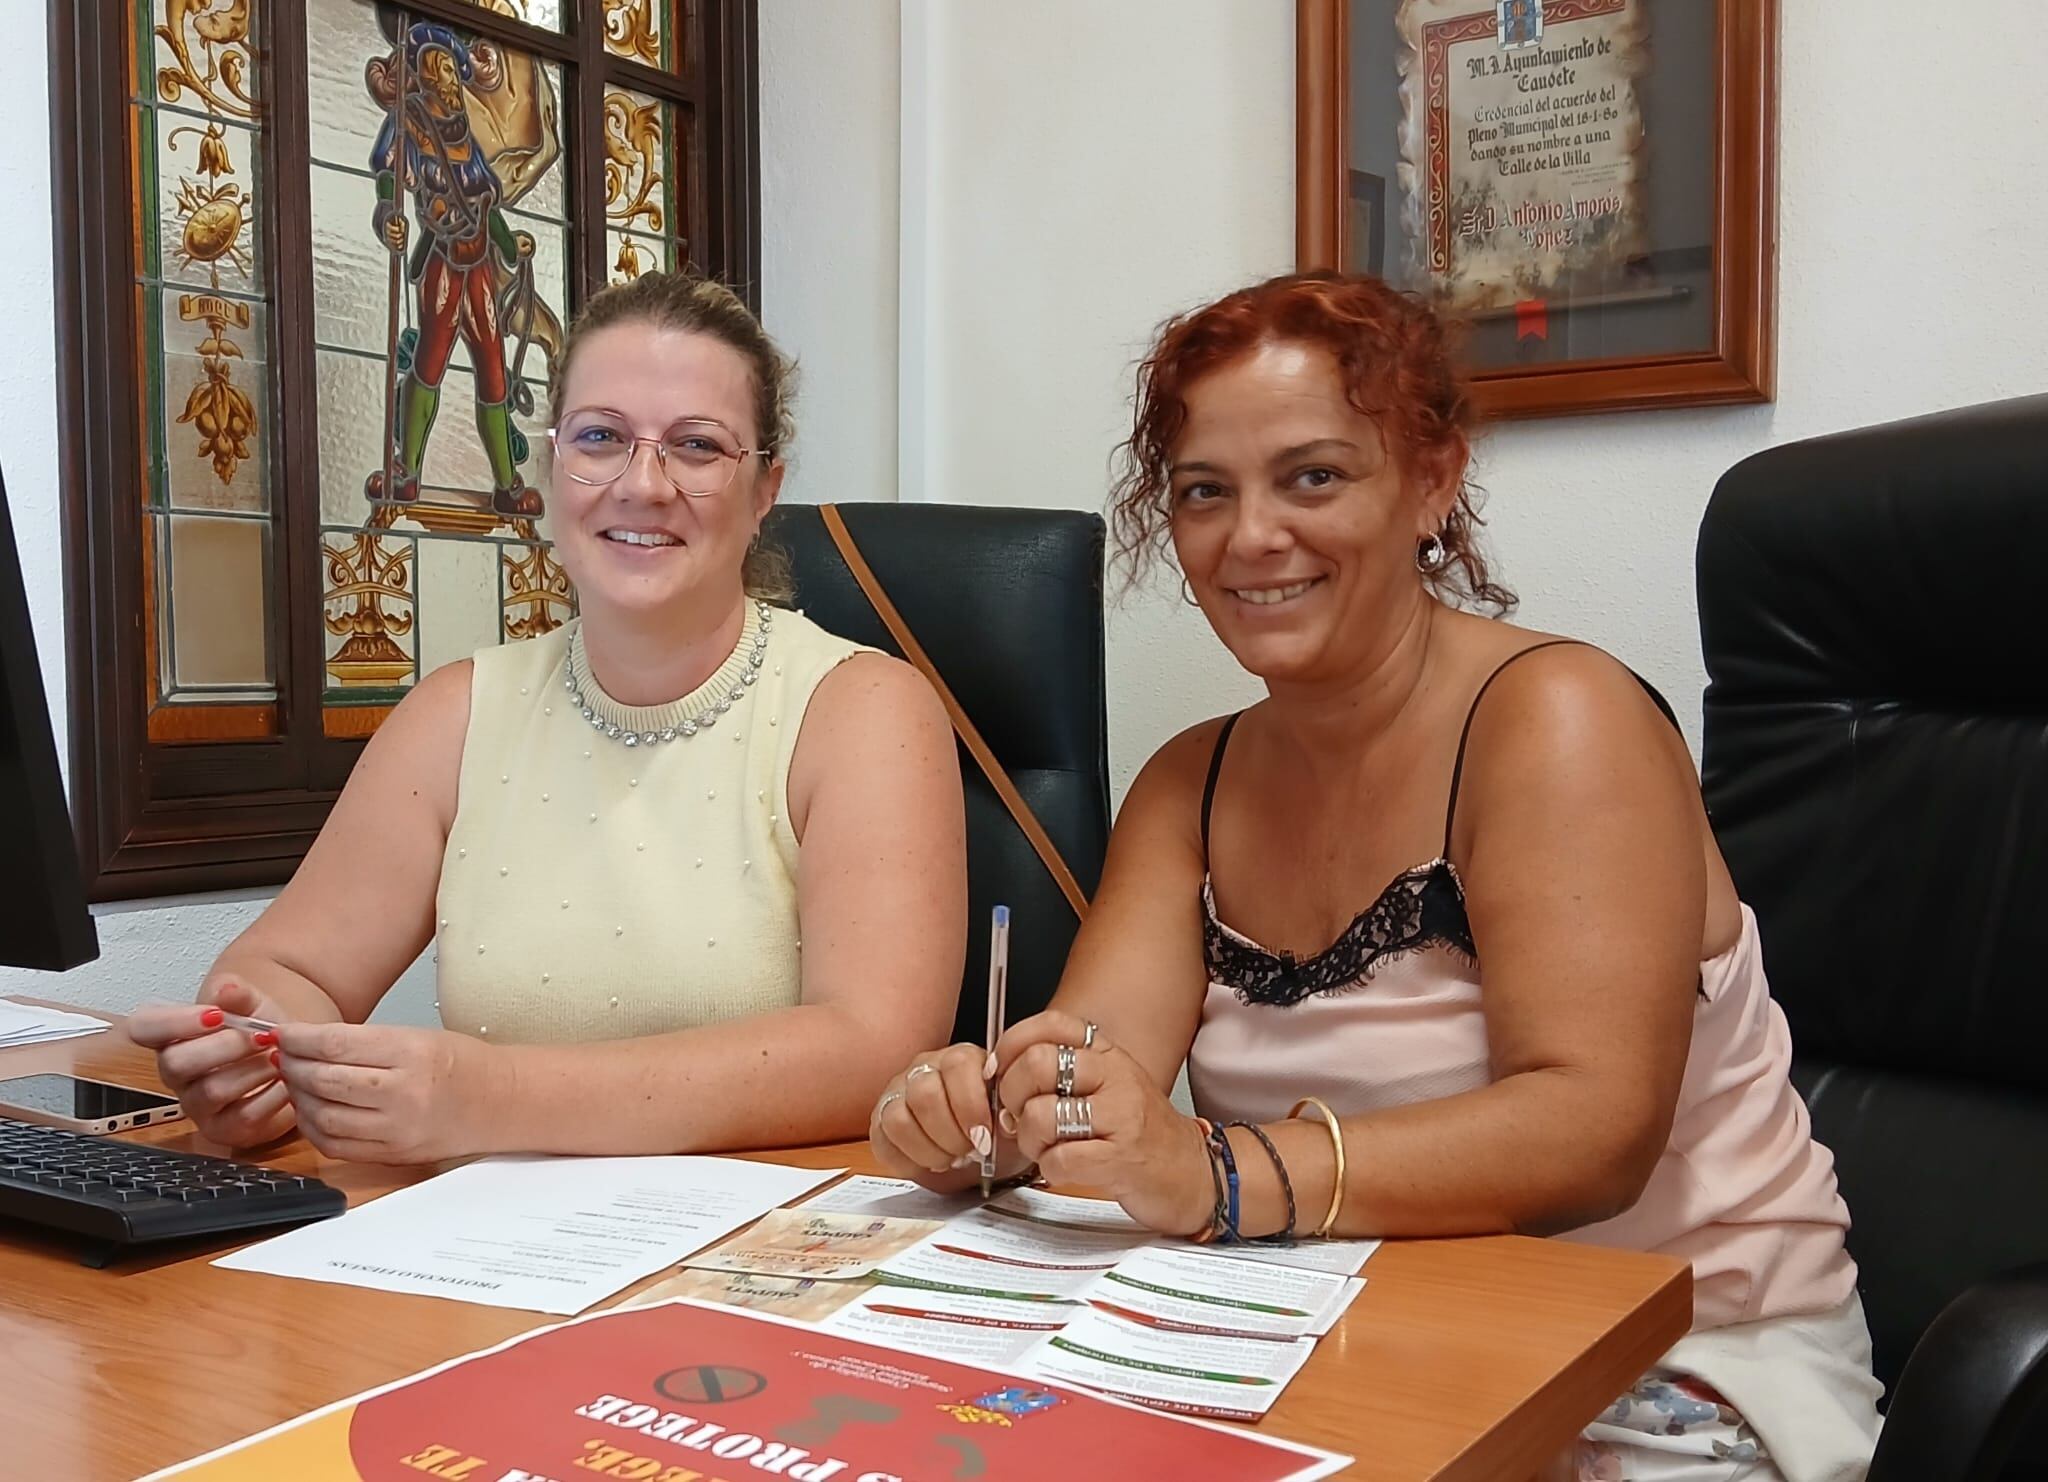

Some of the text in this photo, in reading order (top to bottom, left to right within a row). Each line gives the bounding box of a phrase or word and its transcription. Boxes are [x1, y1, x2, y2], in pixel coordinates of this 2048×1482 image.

[1503, 37, 1594, 73] Ayuntamiento
[1597, 35, 1611, 55] de
[1513, 66, 1576, 93] Caudete
[1474, 84, 1616, 123] Credencial del acuerdo del
[1500, 114, 1559, 139] Municipal
[1560, 113, 1574, 128] del
[1471, 129, 1611, 162] dando su nombre a una
[1498, 149, 1591, 177] Calle de la Villa
[1500, 199, 1565, 230] Antonio
[574, 1394, 849, 1482] PROTEGE
[399, 1444, 488, 1482] TE
